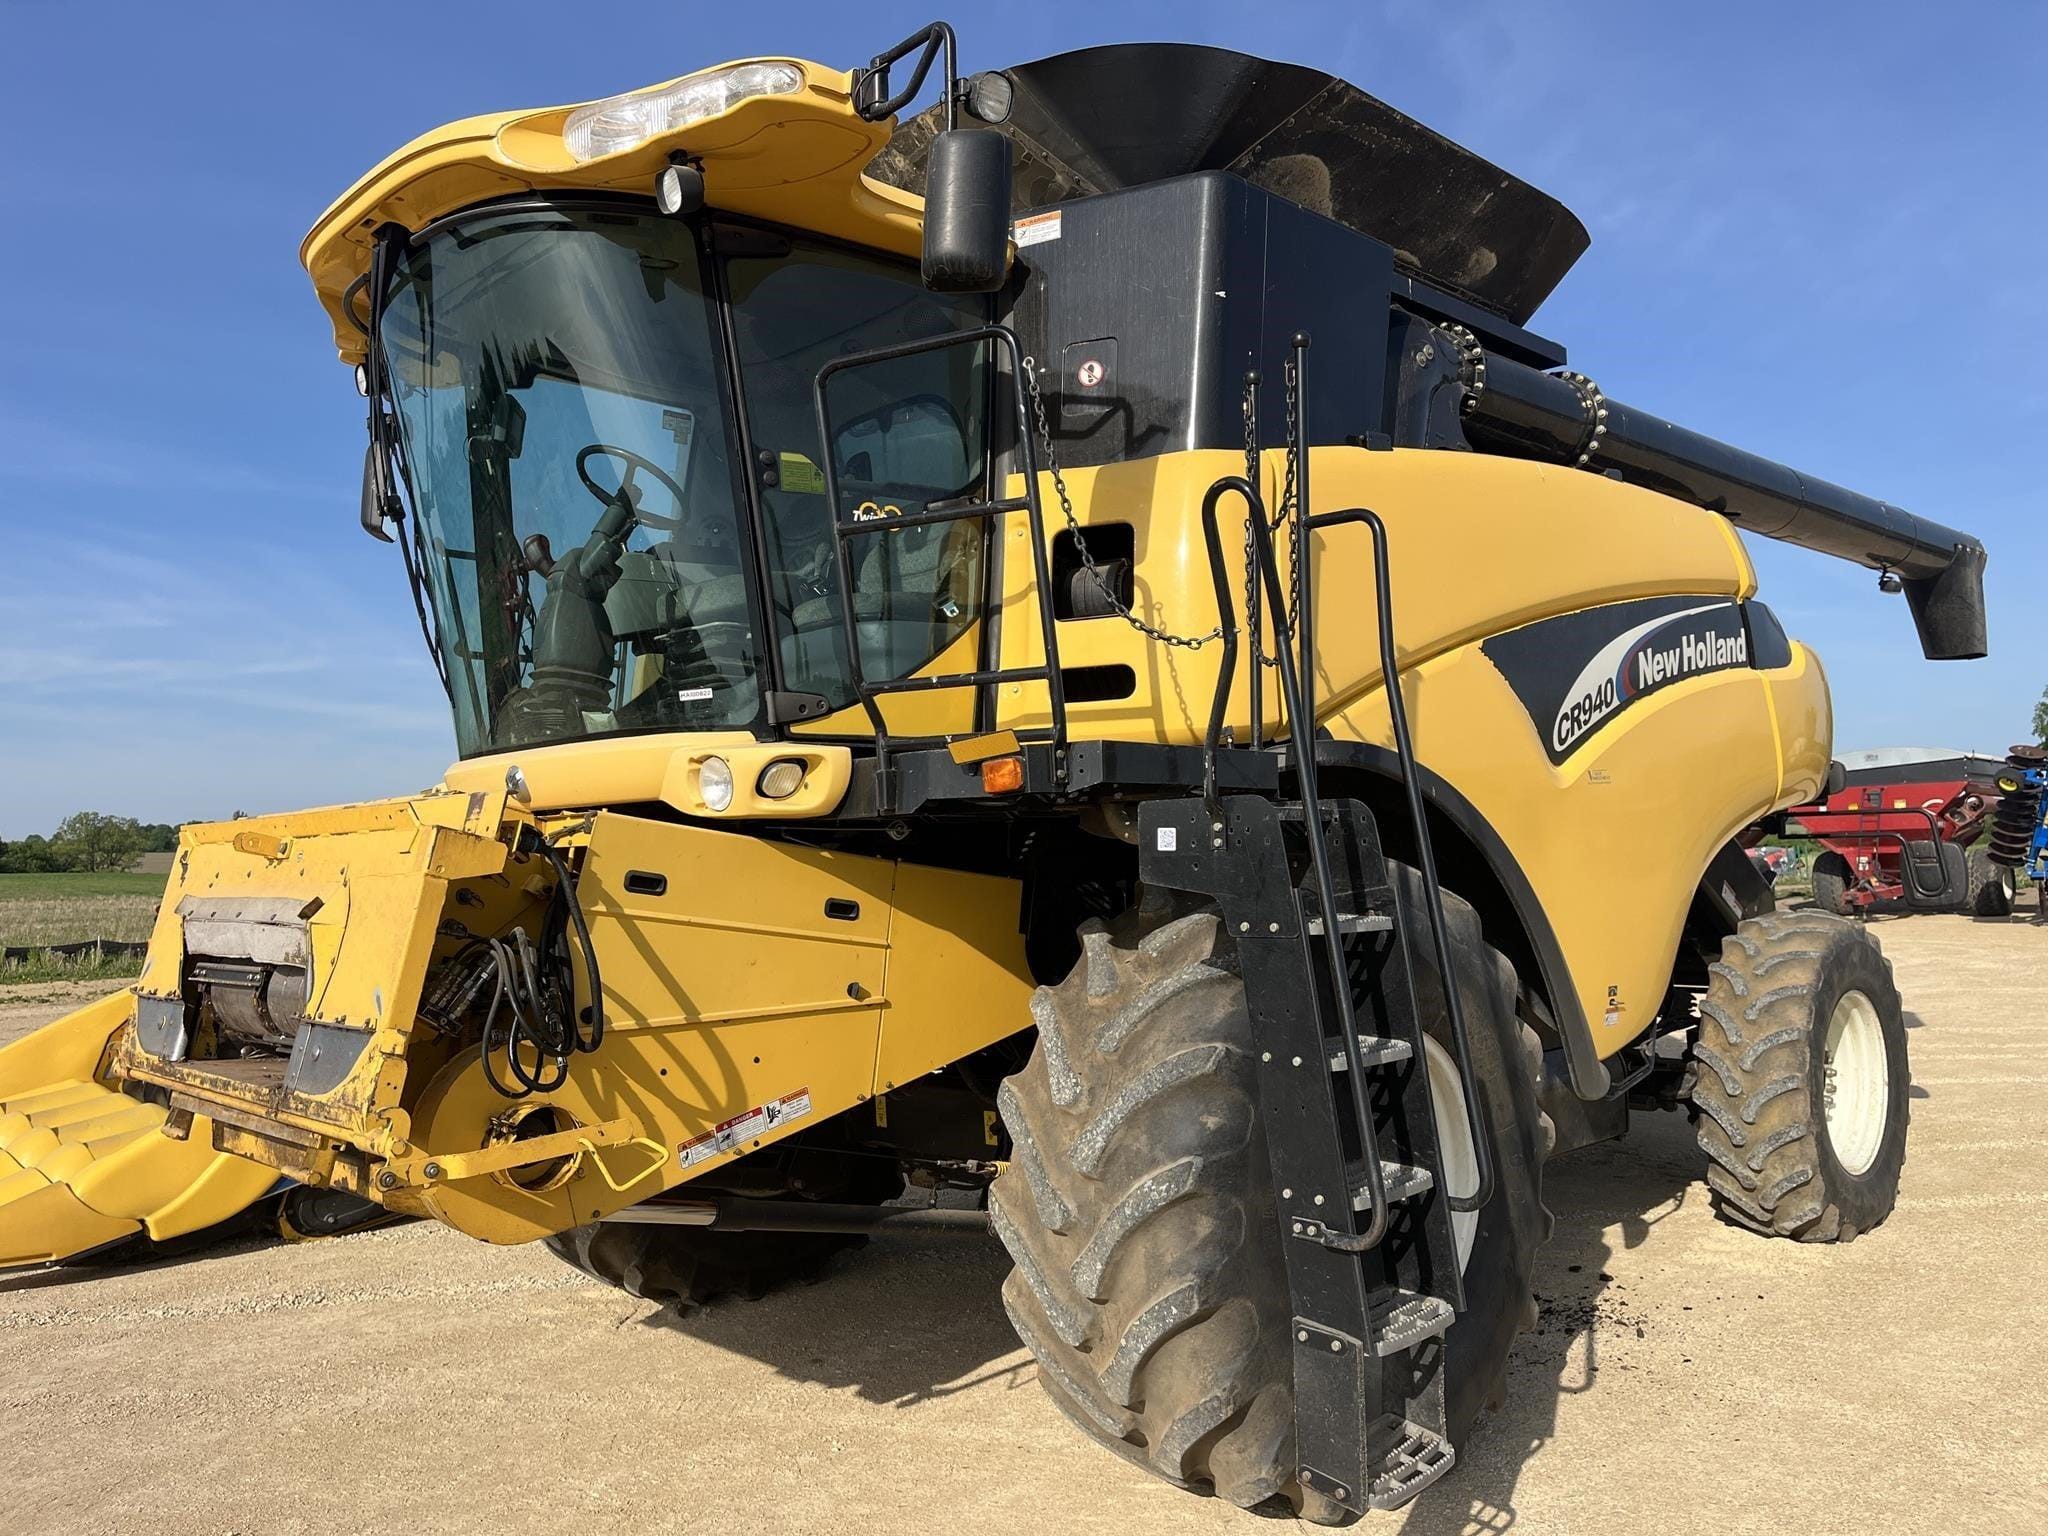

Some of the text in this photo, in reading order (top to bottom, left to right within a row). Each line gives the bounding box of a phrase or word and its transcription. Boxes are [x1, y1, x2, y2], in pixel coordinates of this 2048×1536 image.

[1638, 628, 1746, 689] New Holland
[1557, 677, 1614, 747] CR940
[731, 1112, 754, 1126] DANGER
